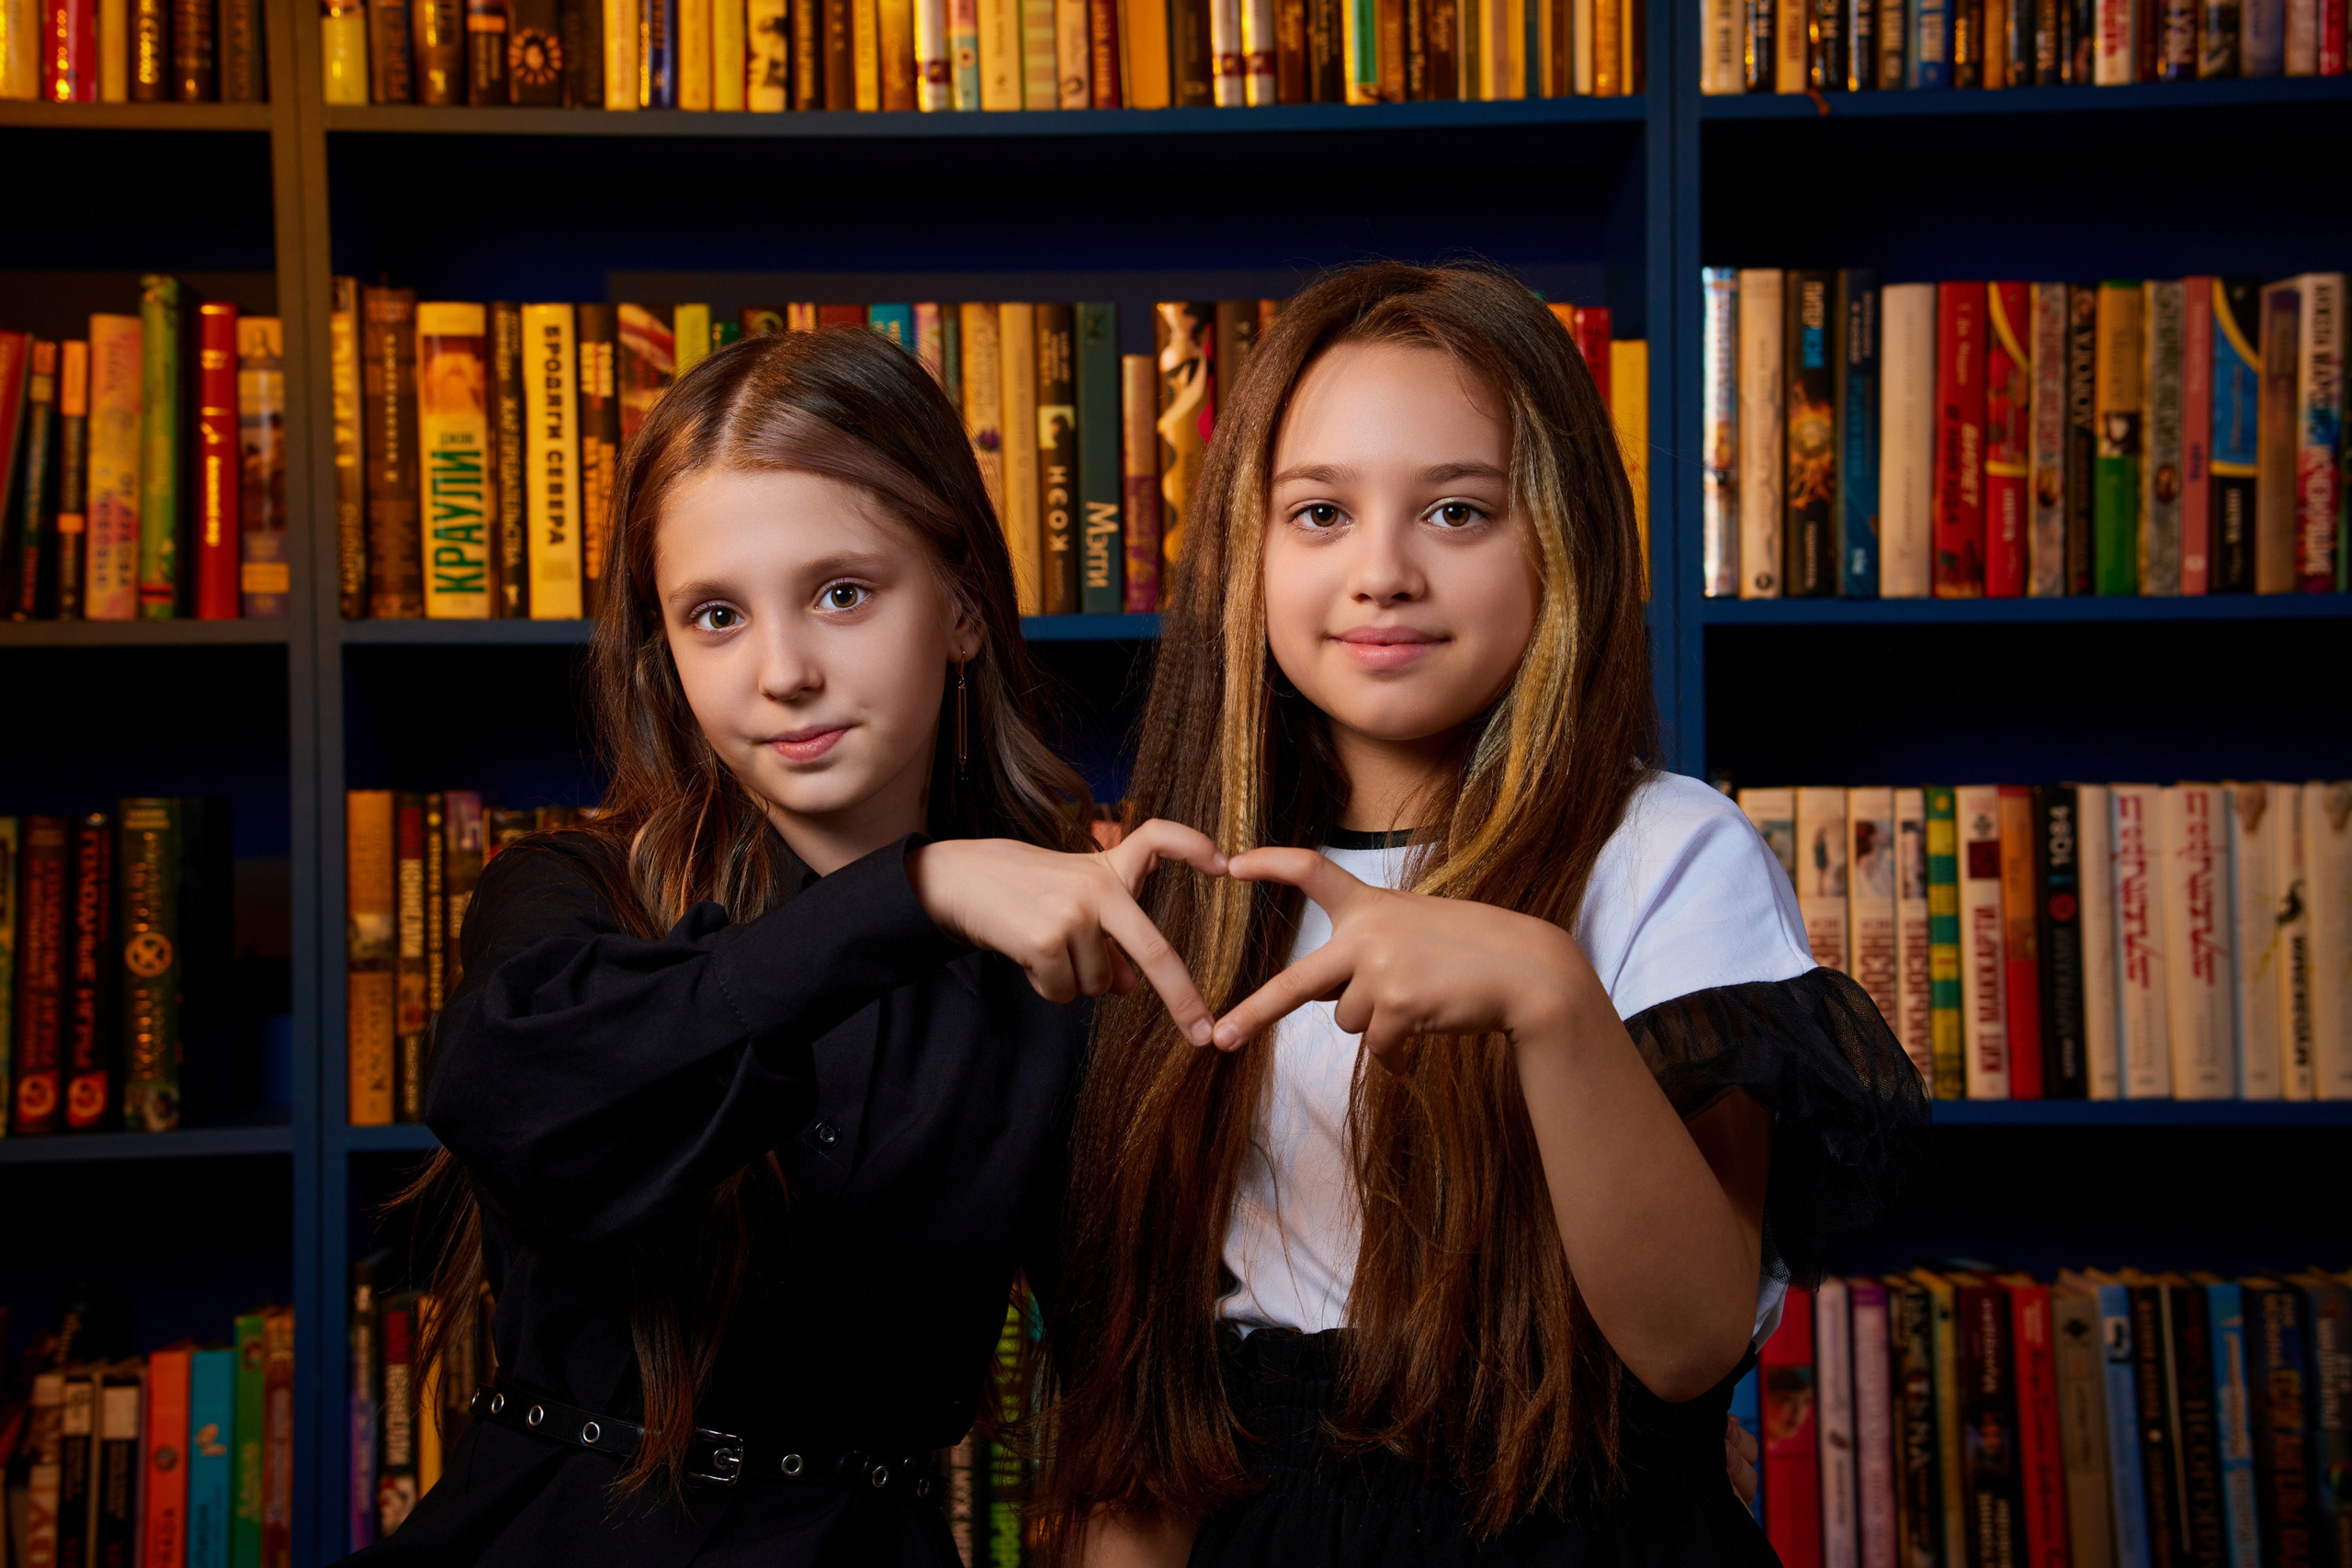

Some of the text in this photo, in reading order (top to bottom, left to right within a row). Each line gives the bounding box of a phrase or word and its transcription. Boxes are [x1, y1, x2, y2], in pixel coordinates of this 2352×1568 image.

[542, 325, 568, 547] БРОДЯГИ СЕВЕРА
[1941, 427, 1961, 525] НИКУДА
[1961, 423, 1979, 509] БИЛЕТ
[429, 449, 485, 593] КРАУЛИ
[501, 436, 524, 568] ПРЕДАТЕЛЬСТВА
[1046, 465, 1071, 553] КОЭН
[1084, 501, 1119, 590] Мэгги
[2047, 805, 2080, 867] 1Q84
